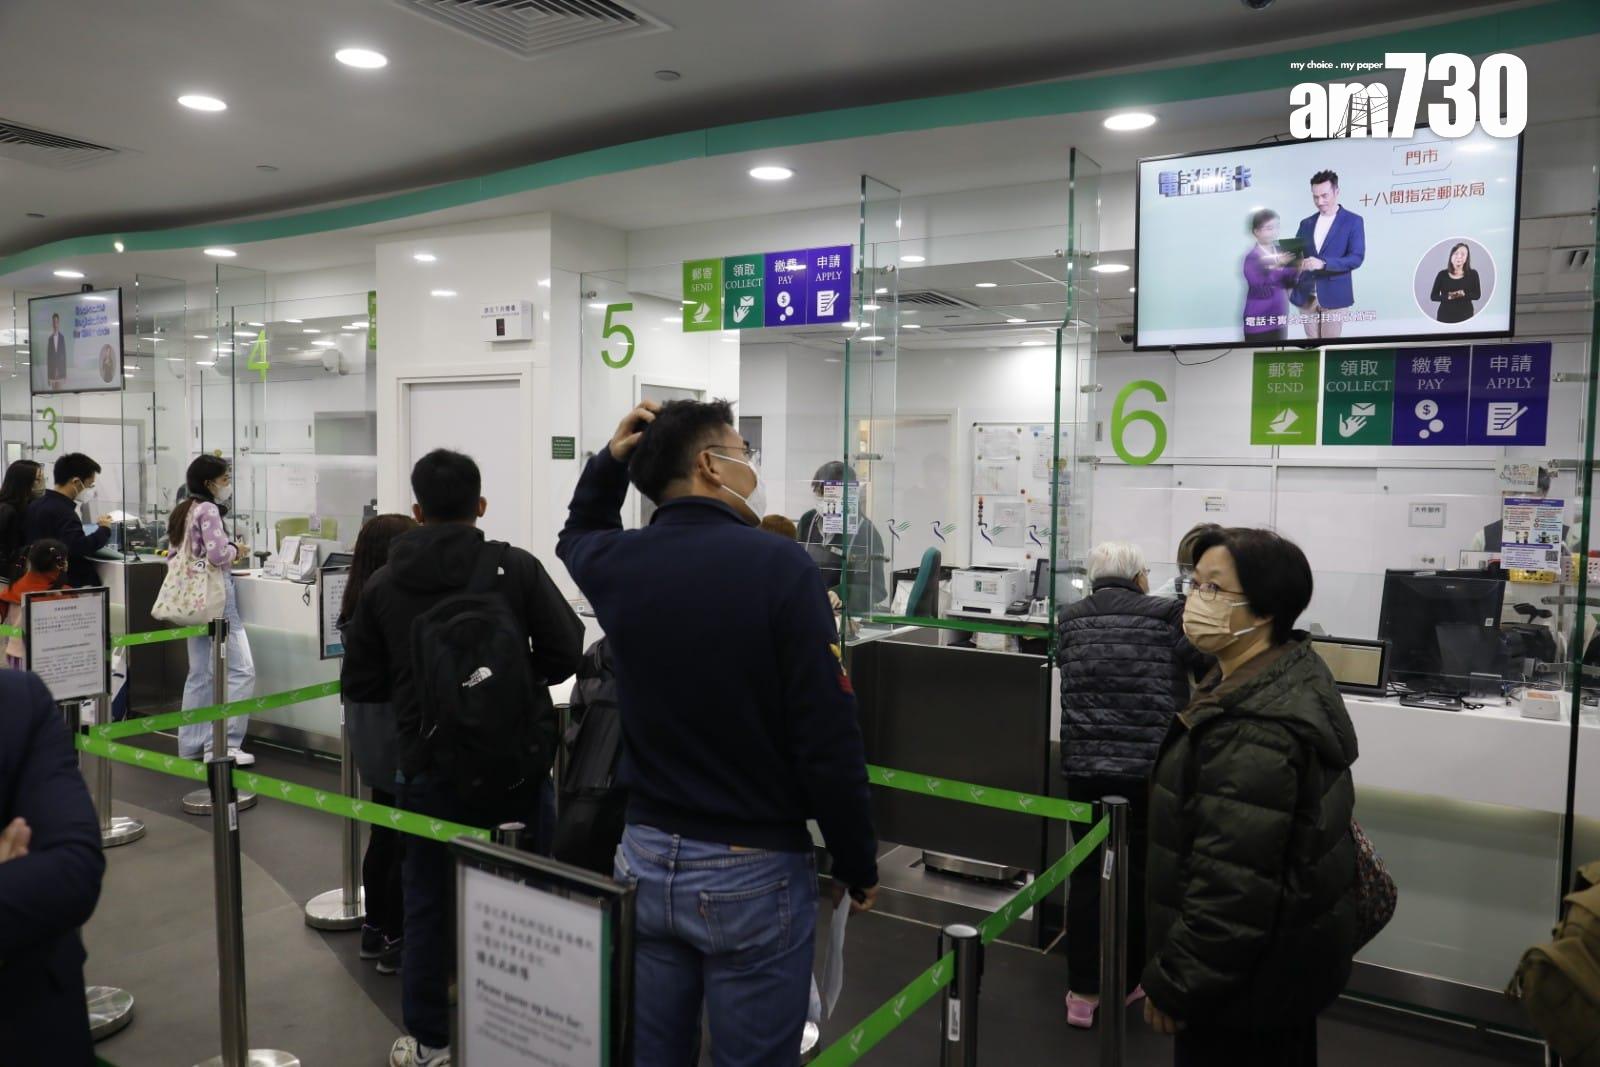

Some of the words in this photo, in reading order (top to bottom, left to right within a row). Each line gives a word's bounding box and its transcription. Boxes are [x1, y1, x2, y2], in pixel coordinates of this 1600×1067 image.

[1405, 149, 1438, 166] 門市
[1359, 182, 1485, 206] 十八間指定郵政局
[817, 254, 841, 269] 申請
[692, 267, 713, 281] 郵寄
[733, 263, 755, 277] 領取
[816, 271, 842, 282] APPLY
[725, 278, 763, 290] COLLECT
[778, 275, 793, 285] PAY
[691, 283, 713, 293] SEND
[601, 302, 635, 369] 5
[247, 329, 269, 380] 4
[1268, 362, 1304, 378] 郵寄
[1340, 360, 1379, 376] 領取
[1411, 356, 1453, 374] 繳費
[1489, 354, 1533, 372] 申請
[1267, 382, 1304, 393] SEND
[1326, 380, 1392, 392] COLLECT
[1417, 378, 1444, 390] PAY
[1486, 377, 1535, 390] APPLY
[42, 406, 57, 451] 3
[1110, 379, 1168, 466] 6
